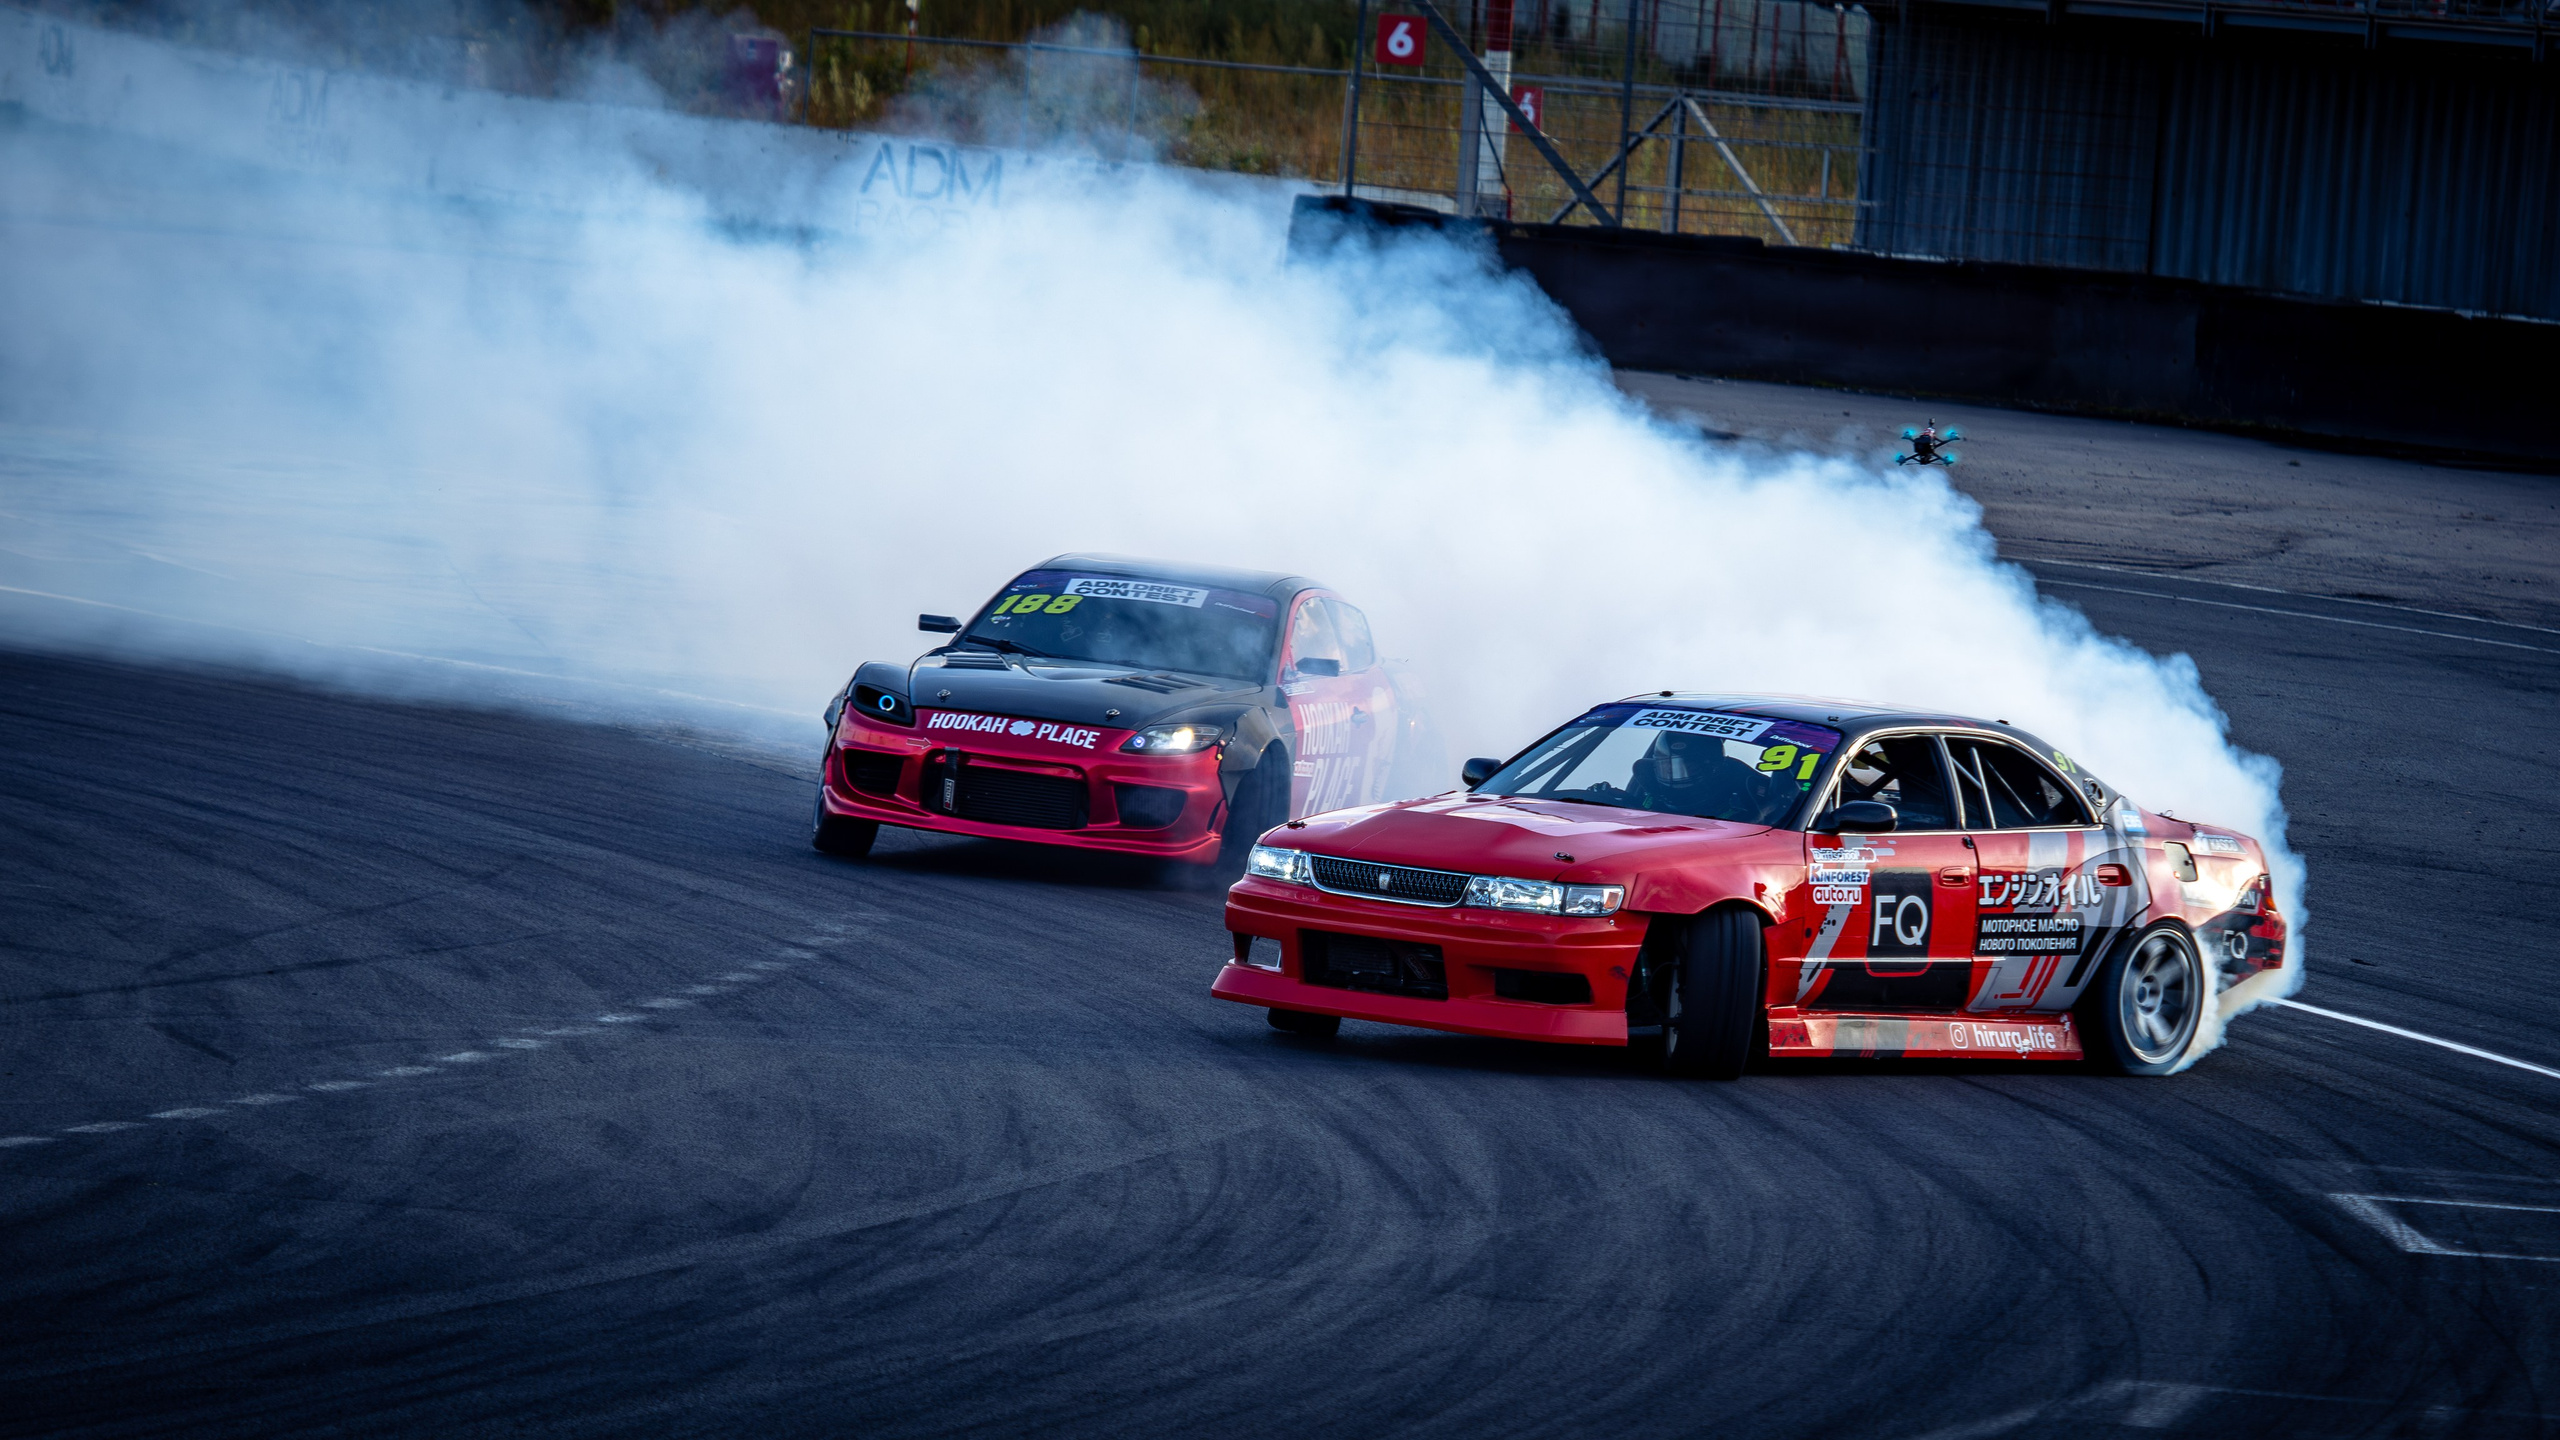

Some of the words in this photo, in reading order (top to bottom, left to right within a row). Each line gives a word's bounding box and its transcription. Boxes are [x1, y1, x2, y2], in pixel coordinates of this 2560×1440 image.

[1387, 21, 1415, 57] 6
[859, 141, 1004, 208] ADM
[1073, 587, 1194, 604] CONTEST
[1078, 580, 1130, 590] ADM
[1133, 583, 1199, 598] DRIFT
[993, 594, 1084, 615] 188
[927, 712, 1009, 734] HOOKAH
[1035, 723, 1101, 750] PLACE
[1633, 718, 1753, 737] CONTEST
[1642, 711, 1696, 721] ADM
[1695, 715, 1763, 729] DRIFT
[1757, 745, 1821, 780] 91
[2053, 751, 2077, 774] 91
[1815, 887, 1860, 902] auto.ru
[1978, 872, 2101, 907] エンジンオイル
[1872, 895, 1928, 946] FQ
[1982, 919, 2037, 933] МОТОРНОЕ
[2038, 919, 2079, 932] МАСЛО
[1979, 938, 2015, 950] НОВОГО
[2017, 937, 2077, 950] ПОКОЛЕНИЯ
[2222, 929, 2248, 960] FQ
